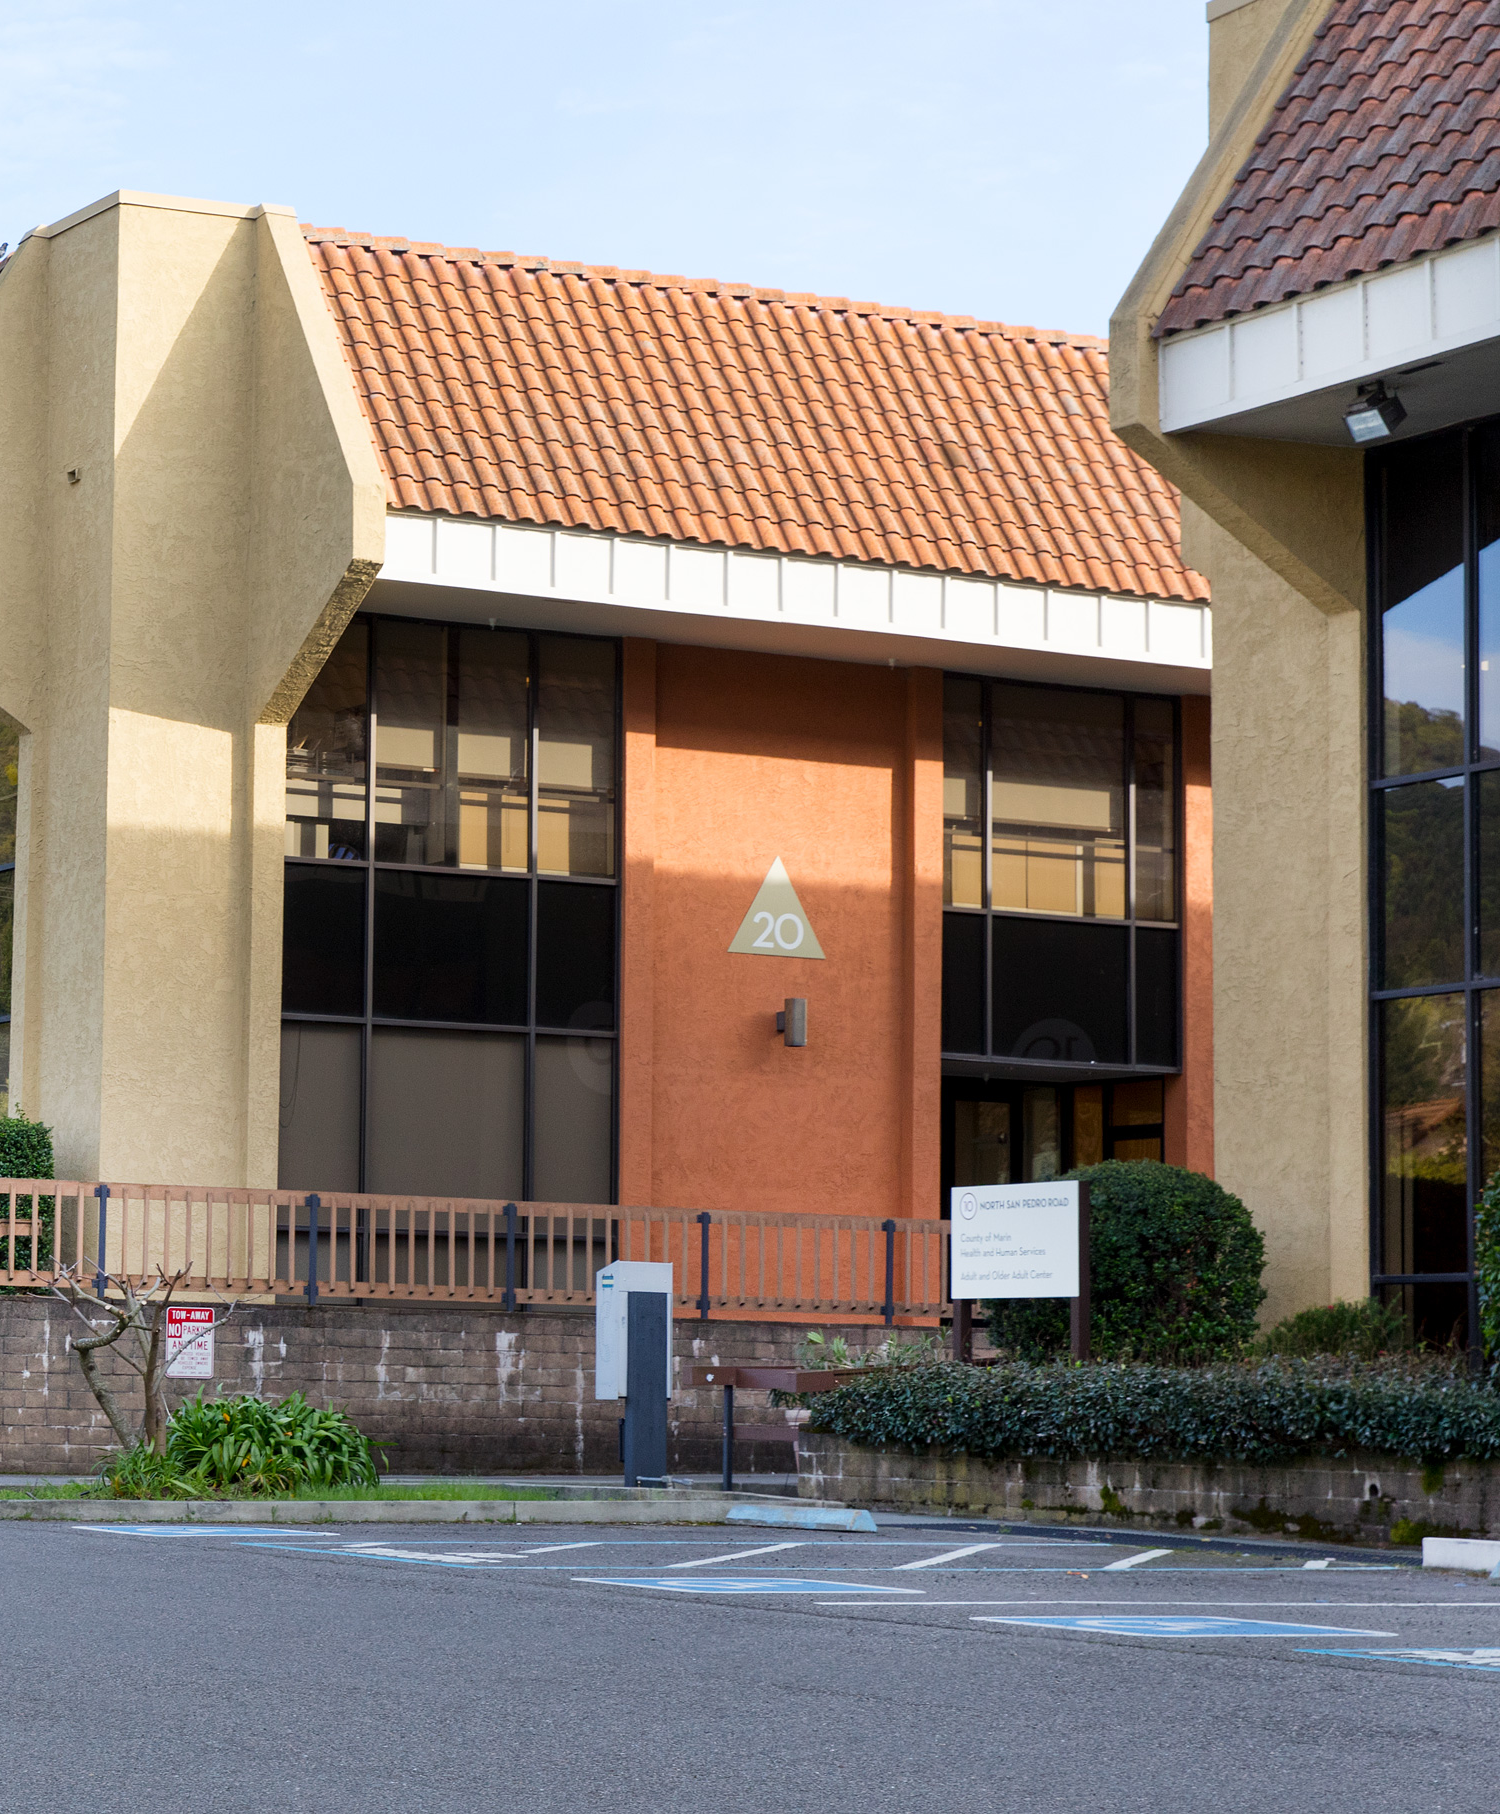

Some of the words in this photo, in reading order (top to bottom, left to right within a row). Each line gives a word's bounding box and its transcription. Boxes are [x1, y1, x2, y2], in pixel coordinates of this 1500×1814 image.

[751, 911, 804, 950] 20
[963, 1200, 974, 1212] 10
[980, 1200, 1004, 1210] NORTH
[1006, 1200, 1020, 1209] SAN
[1022, 1198, 1047, 1208] PEDRO
[1048, 1197, 1069, 1207] ROAD
[960, 1233, 983, 1244] County
[985, 1232, 992, 1241] of
[993, 1232, 1011, 1241] Marin
[960, 1248, 981, 1257] Health
[983, 1248, 994, 1257] and
[995, 1247, 1017, 1256] Human
[1019, 1247, 1046, 1256] Services
[961, 1271, 977, 1280] Adult
[979, 1271, 990, 1280] and
[992, 1270, 1010, 1280] Older
[1012, 1270, 1028, 1279] Adult
[1030, 1269, 1053, 1279] Center
[172, 1310, 210, 1320] TOW-AWAY
[168, 1323, 181, 1337] NO
